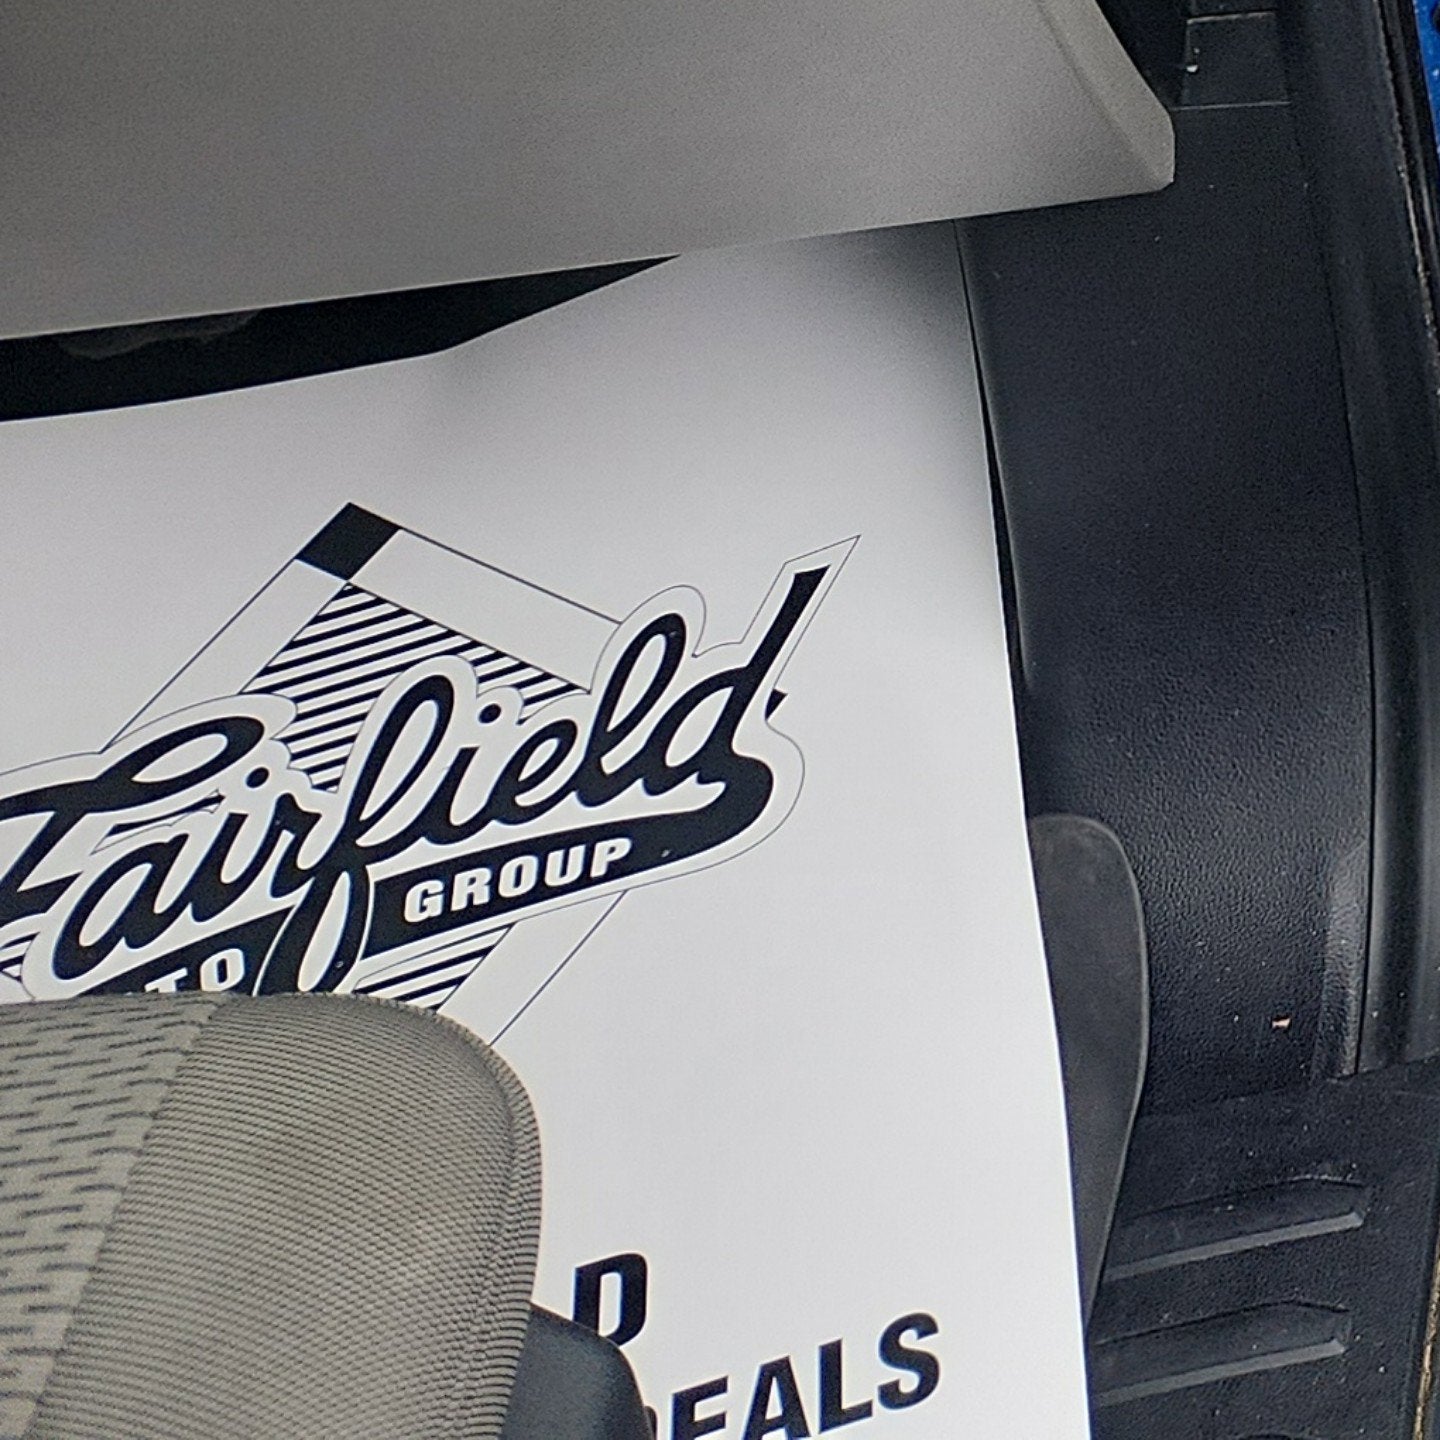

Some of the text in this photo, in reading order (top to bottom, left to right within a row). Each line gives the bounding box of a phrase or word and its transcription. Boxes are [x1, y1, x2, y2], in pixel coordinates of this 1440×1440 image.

[0, 565, 830, 993] Fairfield
[404, 837, 632, 924] GROUP
[644, 1312, 940, 1440] EALS
